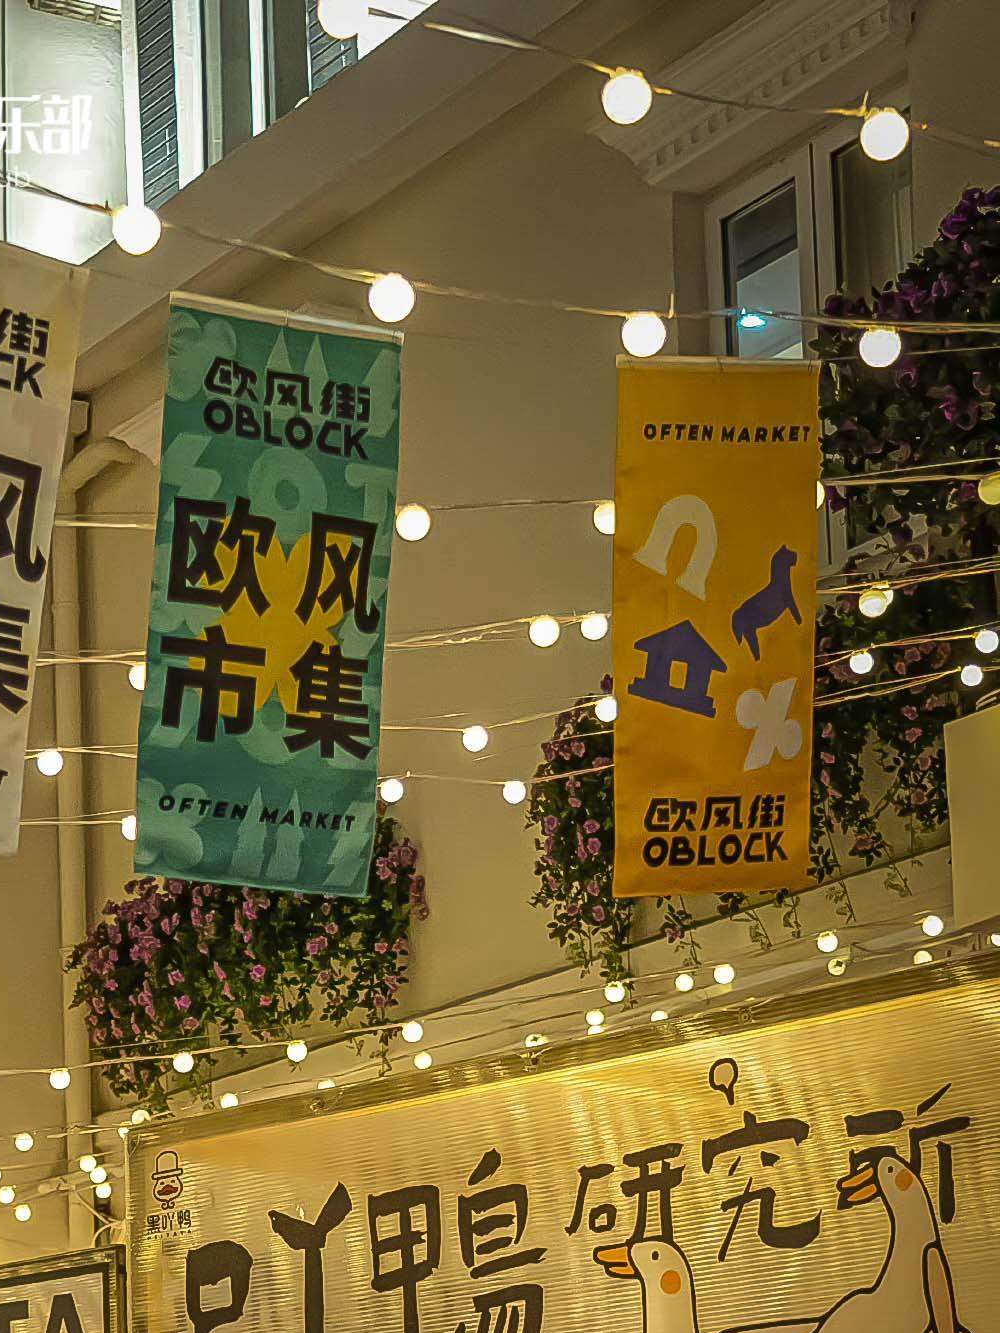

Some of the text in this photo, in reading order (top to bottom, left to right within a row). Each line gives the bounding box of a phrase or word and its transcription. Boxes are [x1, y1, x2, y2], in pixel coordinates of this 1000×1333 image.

[203, 355, 371, 423] 欧风街
[203, 399, 370, 461] OBLOCK
[643, 423, 811, 443] OFTEN MARKET
[166, 495, 380, 634] 欧风
[160, 625, 373, 761] 市集
[158, 794, 356, 833] OFTEN MARKET
[644, 794, 786, 833] 欧风街
[642, 831, 789, 868] OBLOCK
